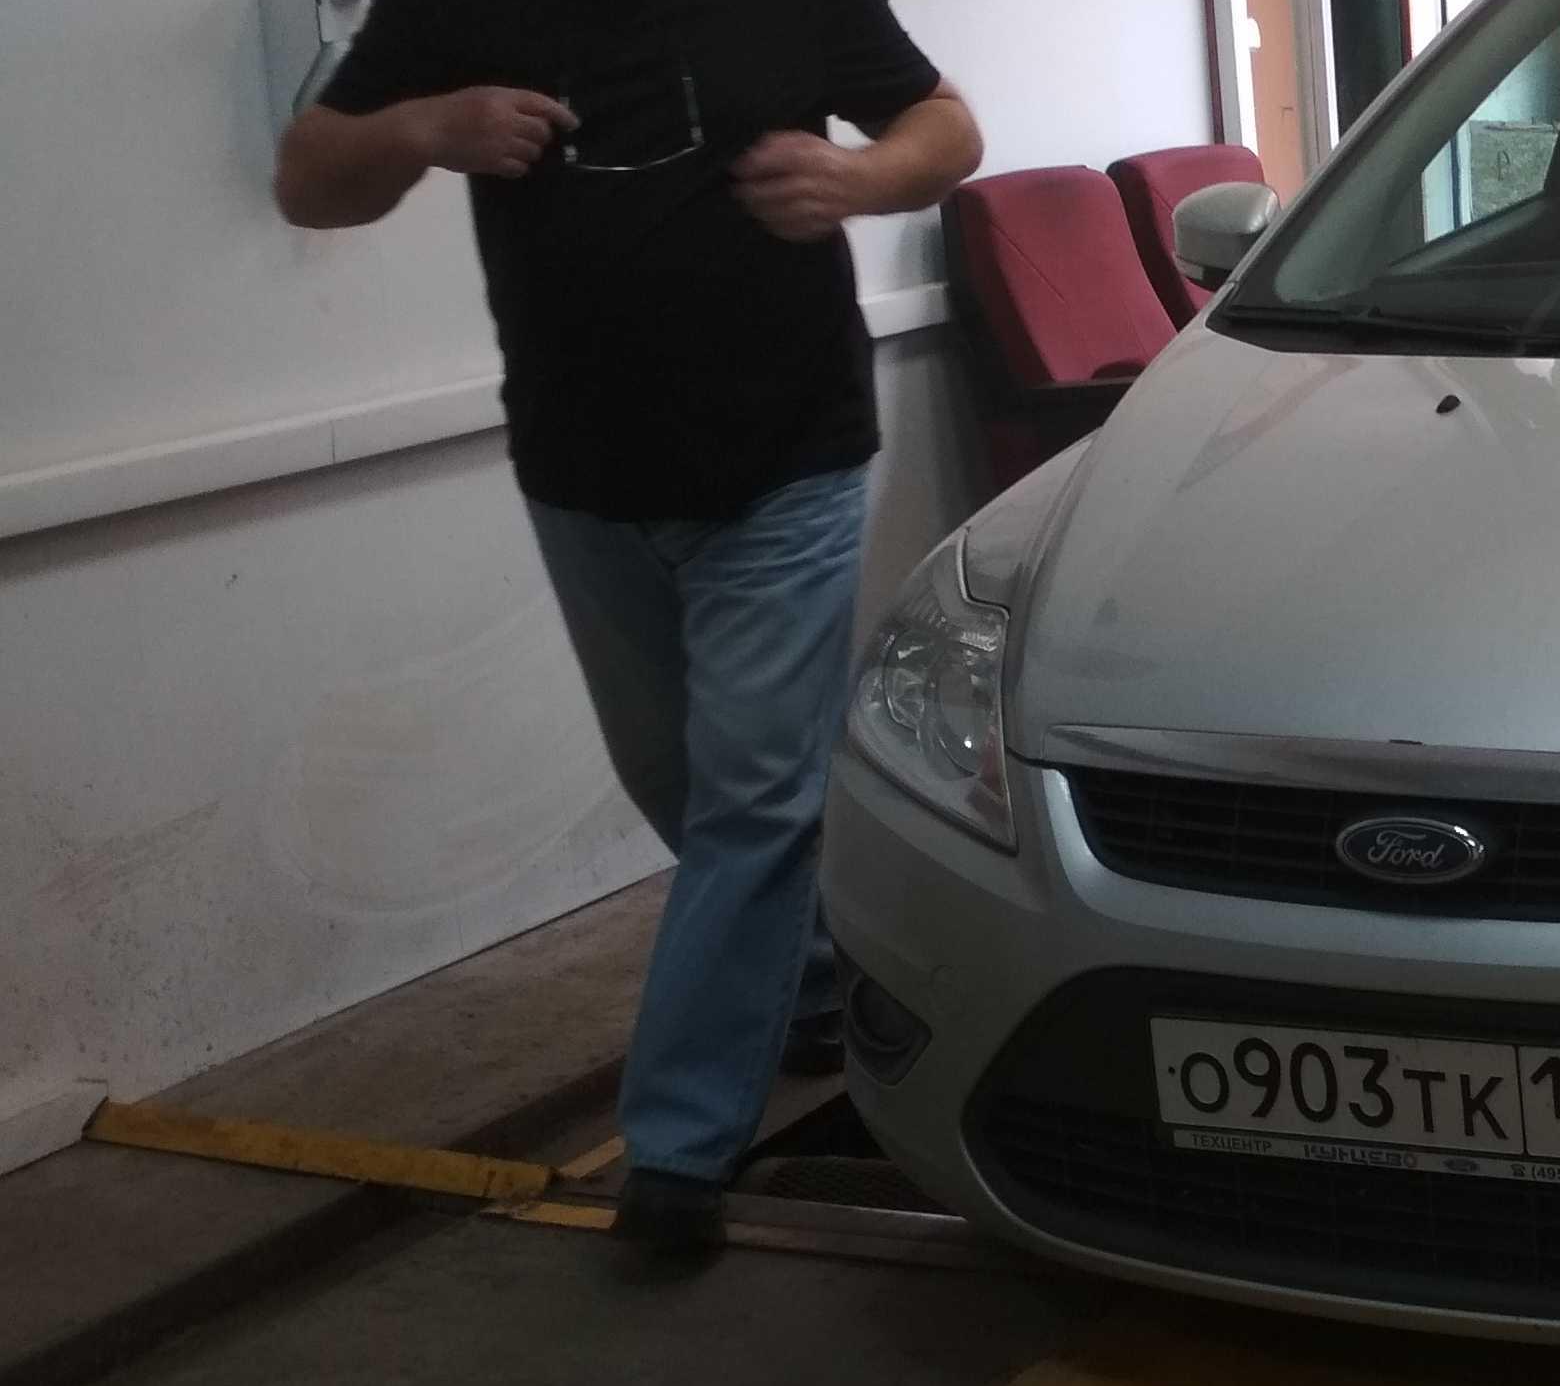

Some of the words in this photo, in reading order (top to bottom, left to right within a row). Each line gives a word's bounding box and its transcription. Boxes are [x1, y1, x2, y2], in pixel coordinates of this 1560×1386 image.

[1367, 830, 1445, 870] Ford
[1179, 1037, 1509, 1141] О903ТК
[1191, 1132, 1273, 1154] ТЕХЦЕНТР
